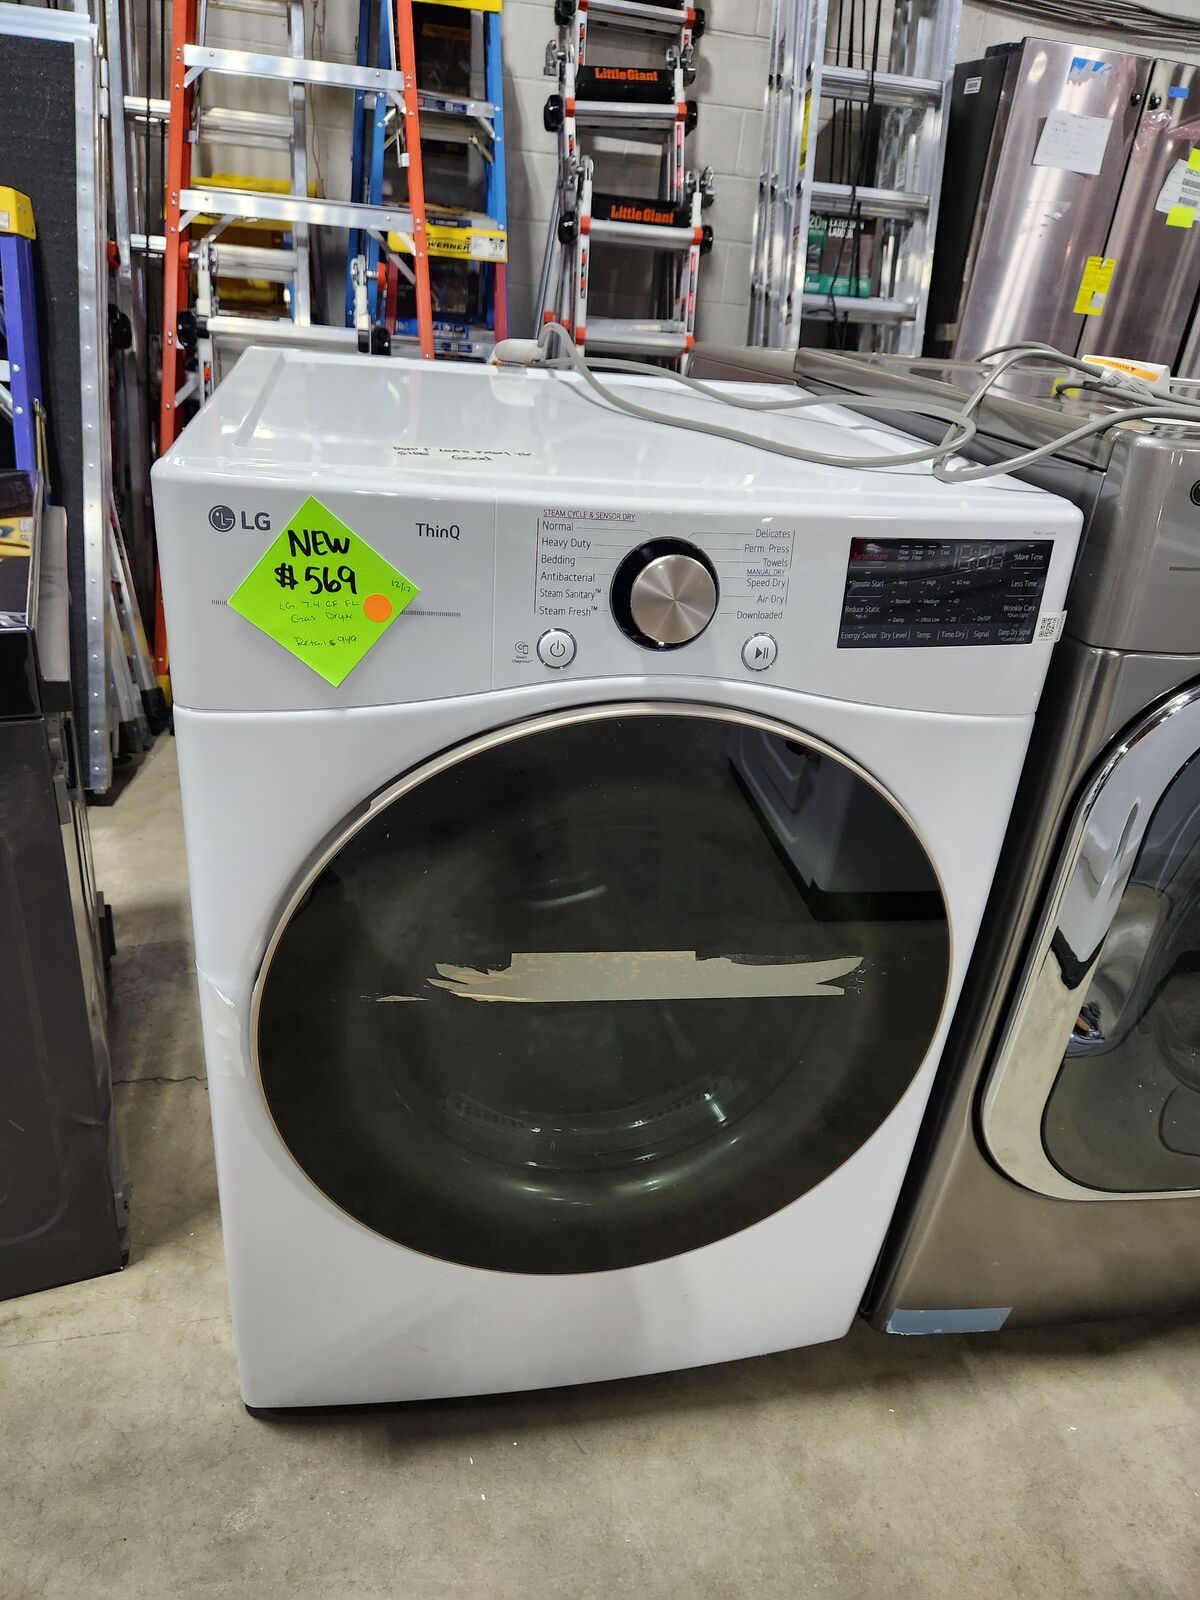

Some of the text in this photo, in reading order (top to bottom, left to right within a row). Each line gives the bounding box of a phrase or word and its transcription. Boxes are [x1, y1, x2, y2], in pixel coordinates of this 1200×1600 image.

[428, 242, 470, 250] WERNER
[544, 508, 566, 517] STEAM
[568, 510, 588, 518] CYCLE
[596, 512, 621, 520] SENSOR
[240, 511, 271, 531] LG
[416, 522, 460, 540] ThinQ
[542, 521, 574, 532] Normal
[756, 528, 792, 539] Delicates
[288, 529, 350, 558] NEW
[542, 536, 592, 550] Heavy Duty
[744, 544, 790, 554] Perm. Press
[541, 554, 576, 567] Bedding
[763, 558, 788, 568] Towels
[541, 571, 596, 582] Antibacterial
[746, 578, 786, 590] Speed Dry
[871, 580, 884, 588] Start
[540, 588, 564, 598] Steam
[326, 600, 338, 608] CF
[756, 594, 784, 606] Air Dry
[540, 606, 566, 616] Steam
[736, 610, 783, 620] Downloaded
[290, 614, 317, 624] Gas
[840, 632, 860, 640] Energy
[881, 631, 908, 640] Dry Level
[916, 631, 932, 640] Temp
[955, 630, 966, 640] Dry
[974, 630, 990, 638] Signal
